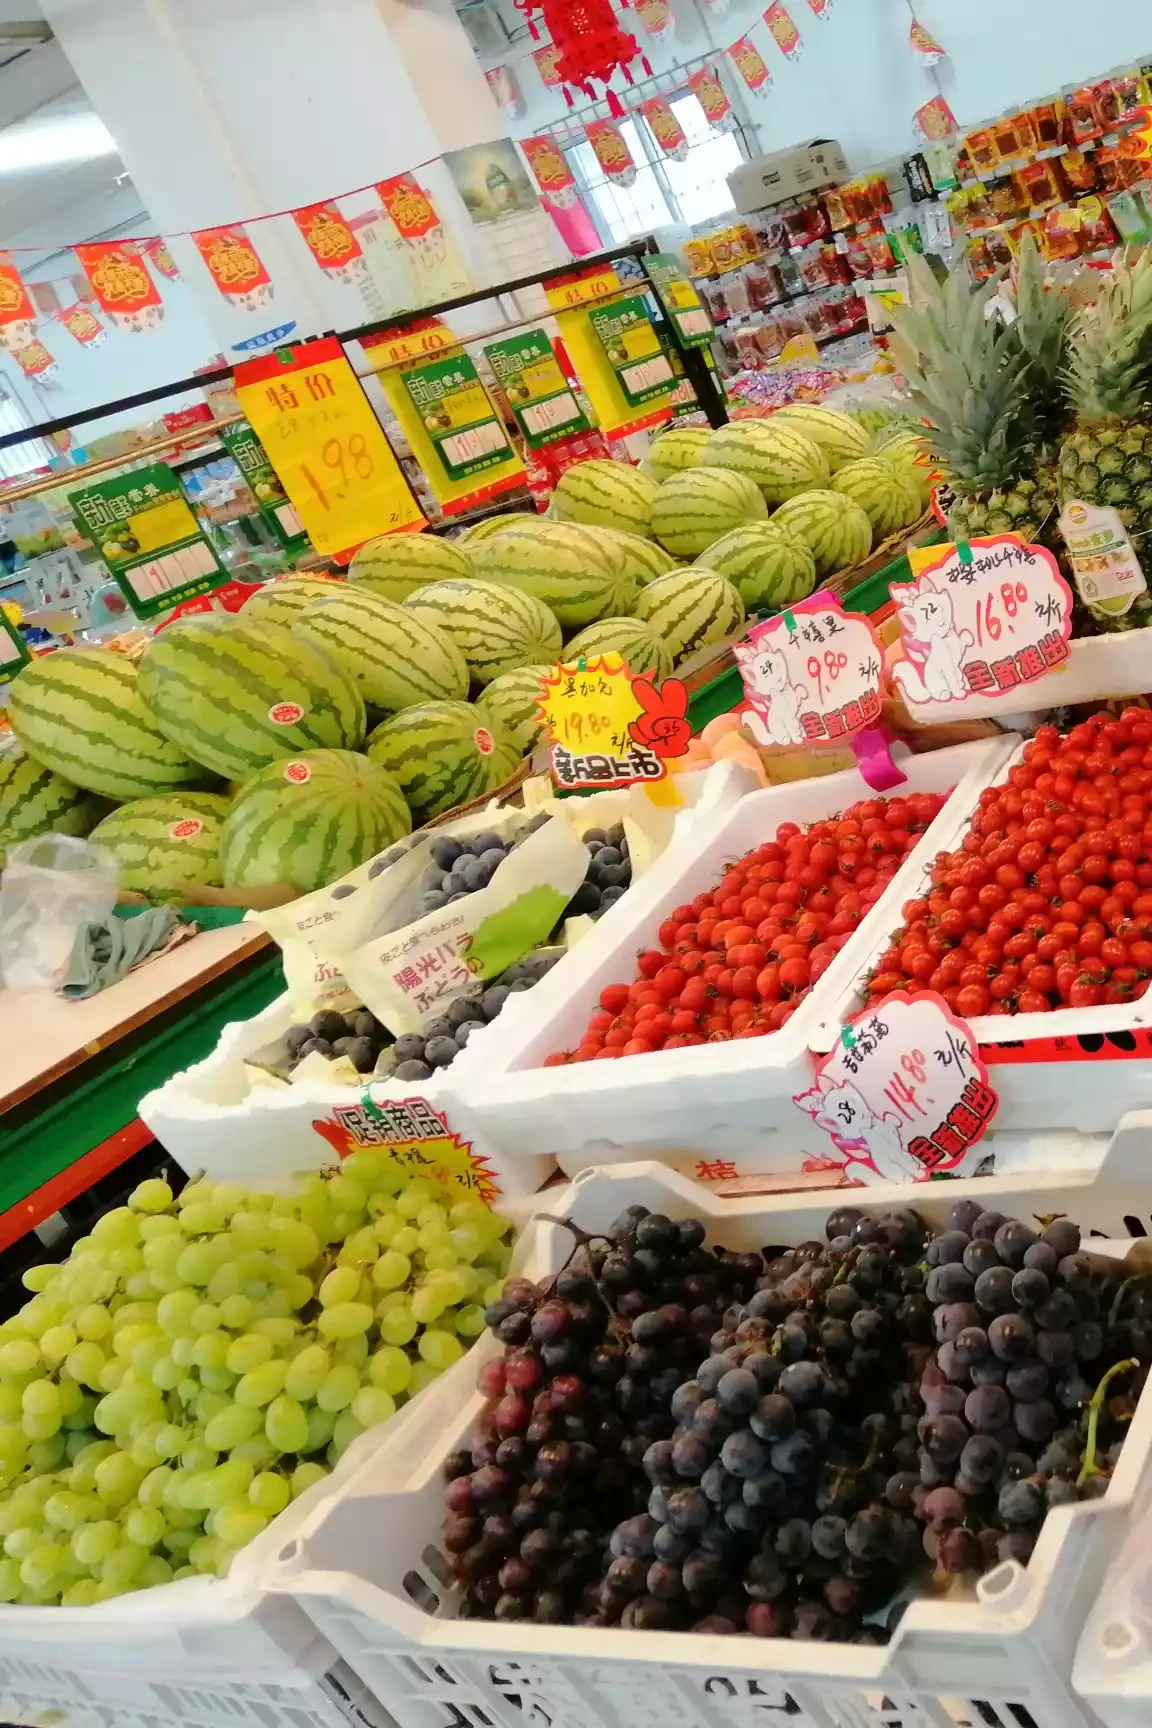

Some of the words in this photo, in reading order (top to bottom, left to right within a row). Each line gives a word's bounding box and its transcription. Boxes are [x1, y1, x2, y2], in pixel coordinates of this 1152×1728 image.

[264, 372, 337, 413] 特价
[300, 433, 374, 512] 1.98
[974, 582, 1029, 648] 16.80
[1034, 593, 1063, 628] 元/斤
[807, 650, 848, 706] 9.80
[963, 629, 1070, 692] 全新推出
[564, 711, 612, 744] 19.80
[800, 687, 880, 740] 全新推出
[553, 744, 661, 784] 新品上市
[837, 1099, 857, 1125] 28
[883, 1048, 936, 1123] 14.80
[907, 1075, 998, 1169] 全新推出
